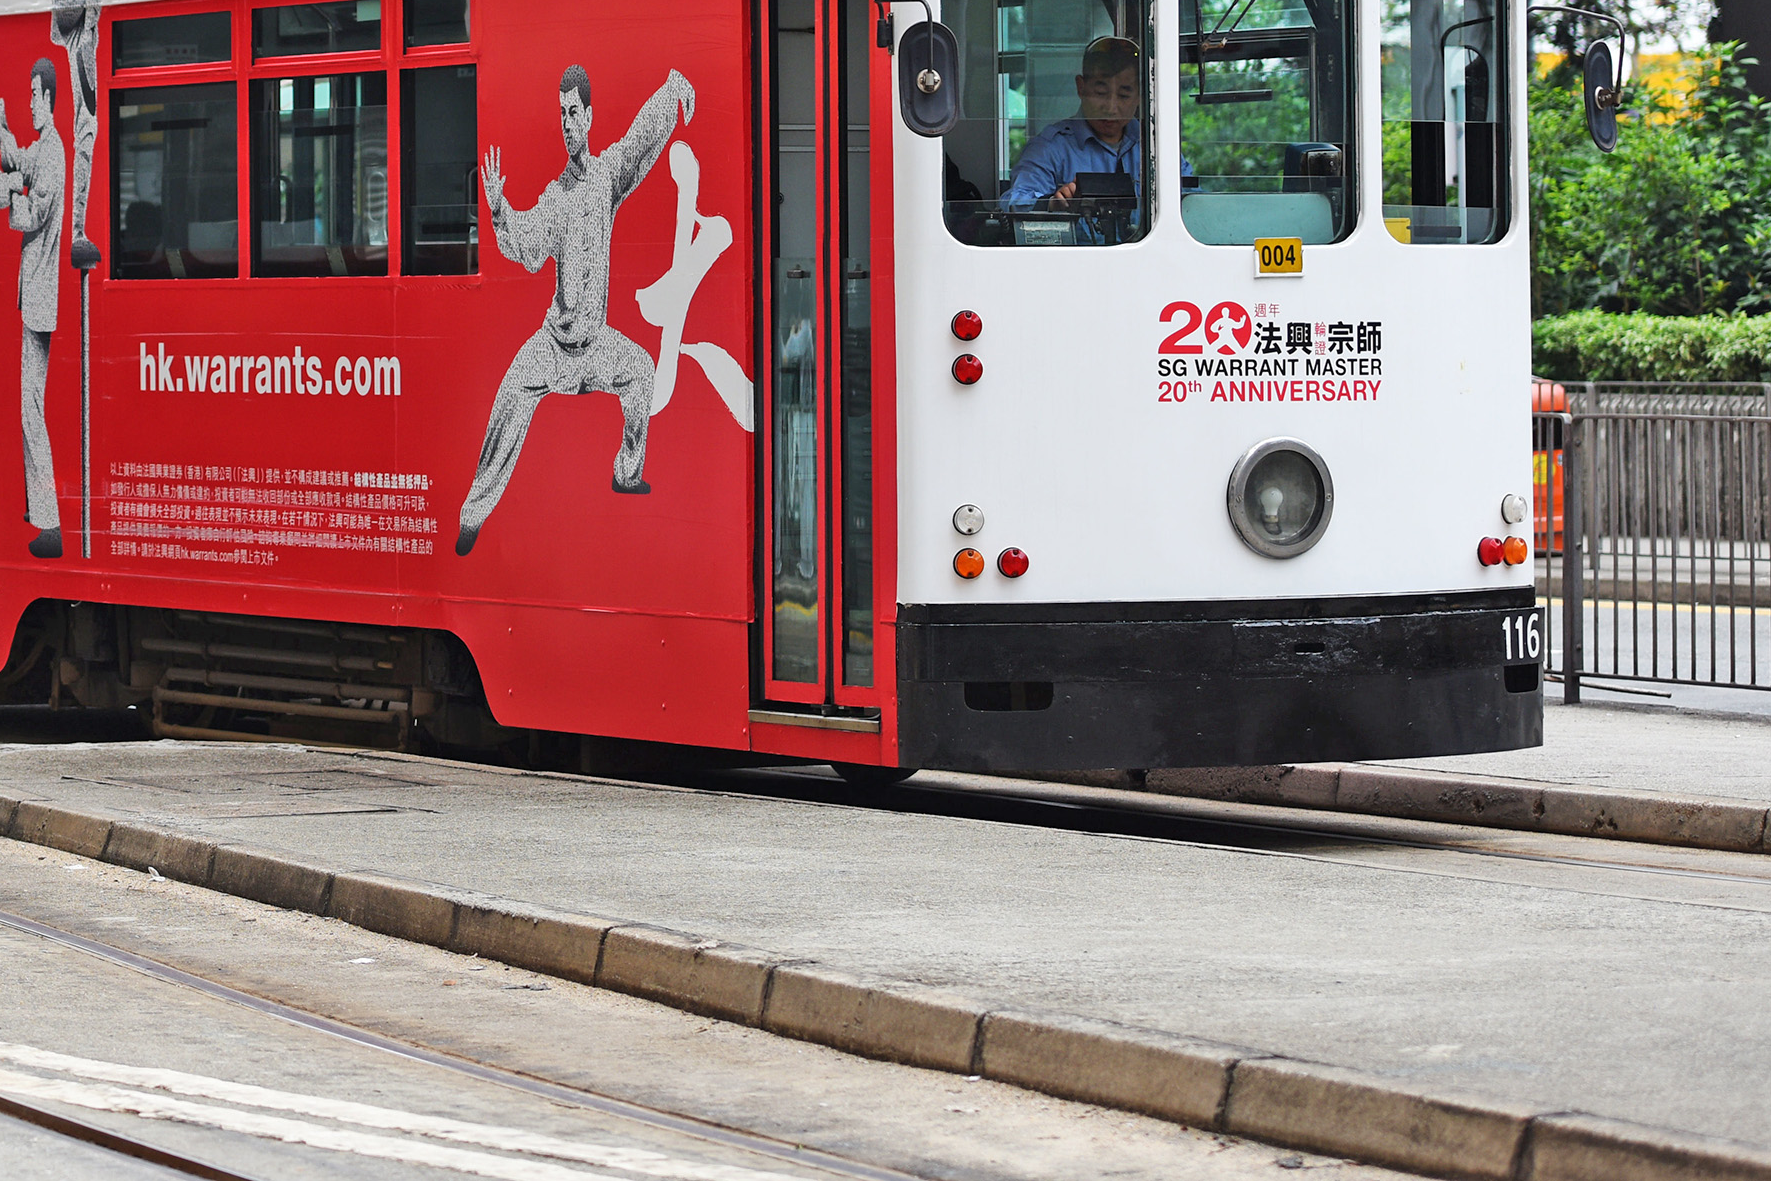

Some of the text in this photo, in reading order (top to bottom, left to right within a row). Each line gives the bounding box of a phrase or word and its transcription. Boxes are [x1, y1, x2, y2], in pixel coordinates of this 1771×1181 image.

[1261, 243, 1297, 267] 004
[1253, 302, 1281, 319] 週年
[139, 342, 402, 396] hk.warrants.com
[1157, 357, 1383, 378] SG WARRANT MASTER
[1157, 379, 1383, 403] 20th ANNIVERSARY
[1501, 612, 1540, 661] 116
